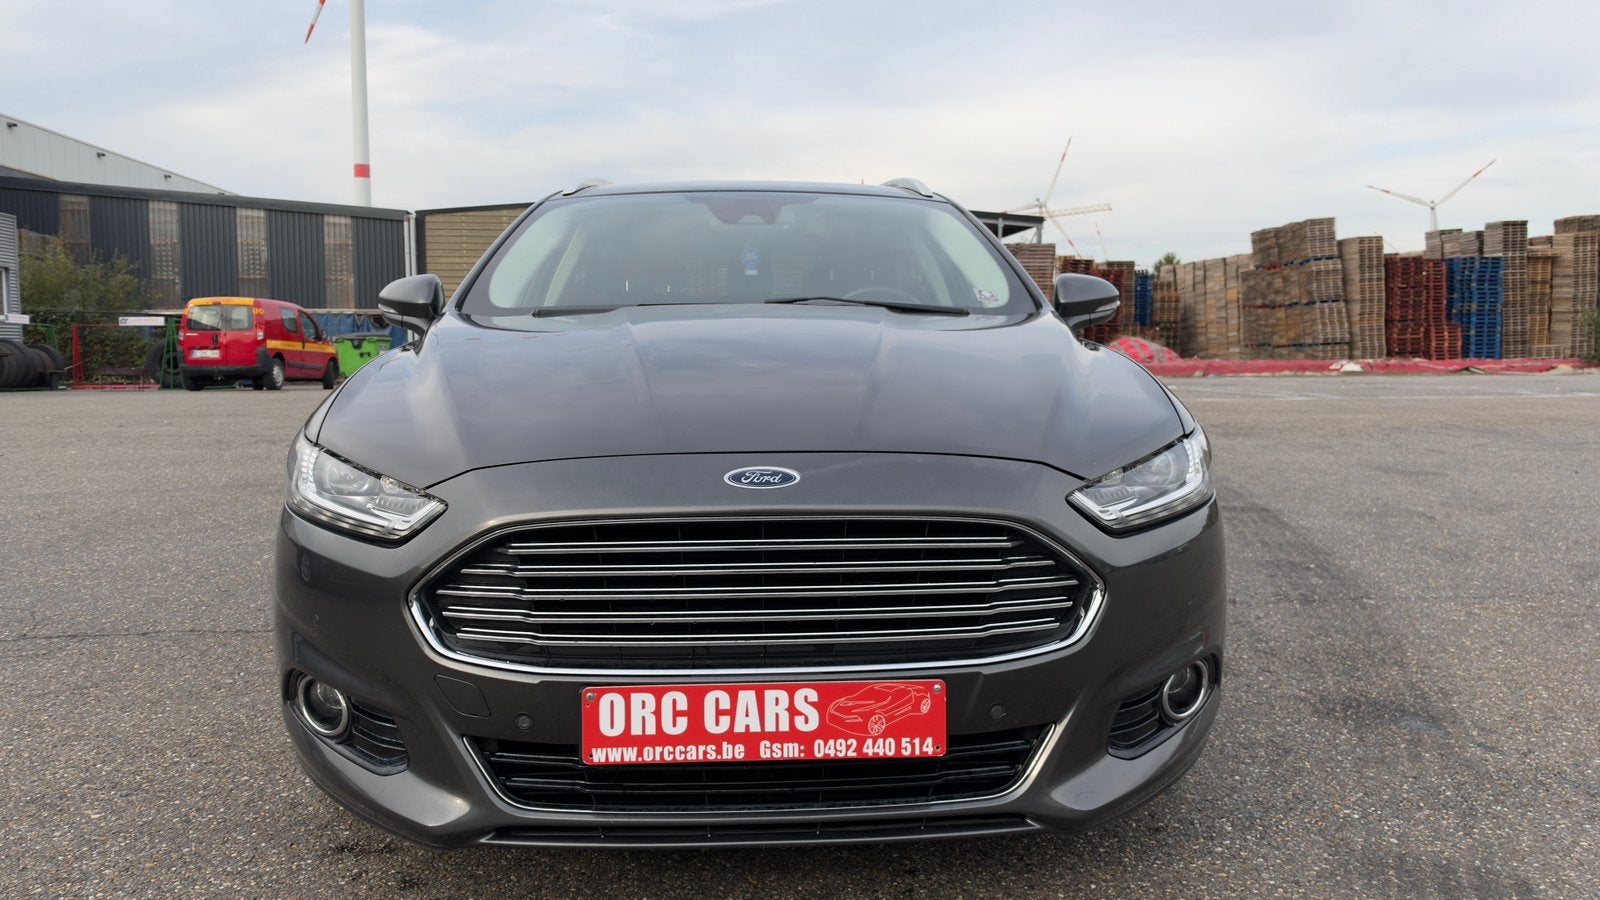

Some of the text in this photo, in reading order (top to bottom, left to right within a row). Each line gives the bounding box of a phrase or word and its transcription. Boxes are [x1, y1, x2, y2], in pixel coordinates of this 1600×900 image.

[741, 470, 782, 483] Ford
[598, 687, 820, 737] ORC CARS
[591, 736, 934, 763] www.orccars.be Gsm: 0492 440 514
